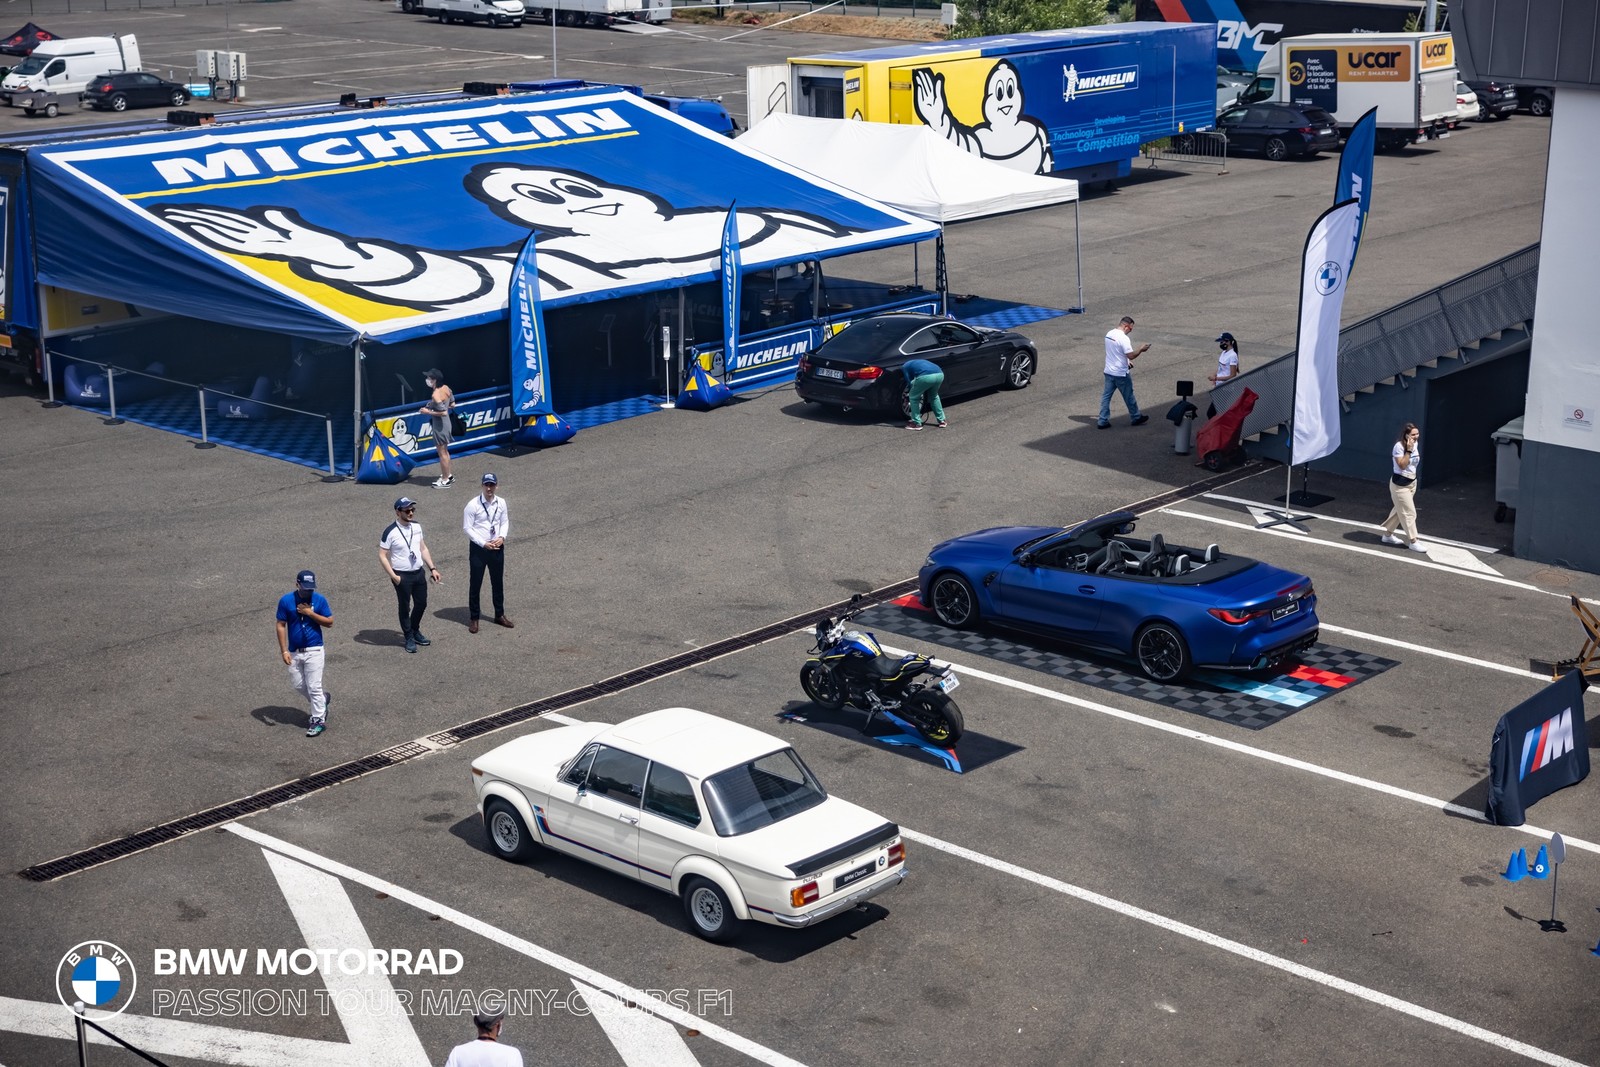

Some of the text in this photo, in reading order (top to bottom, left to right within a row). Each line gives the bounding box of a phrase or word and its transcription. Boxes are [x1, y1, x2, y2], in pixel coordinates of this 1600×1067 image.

[1348, 51, 1402, 69] ucar
[1426, 43, 1448, 58] ucar
[1078, 71, 1136, 90] MICHELIN
[1053, 126, 1104, 140] Technology in
[1077, 132, 1140, 152] Competition
[152, 108, 631, 185] MICHELIN
[518, 263, 537, 371] MICHELIN
[737, 340, 808, 369] MICHELIN
[844, 868, 868, 882] BMW Classic
